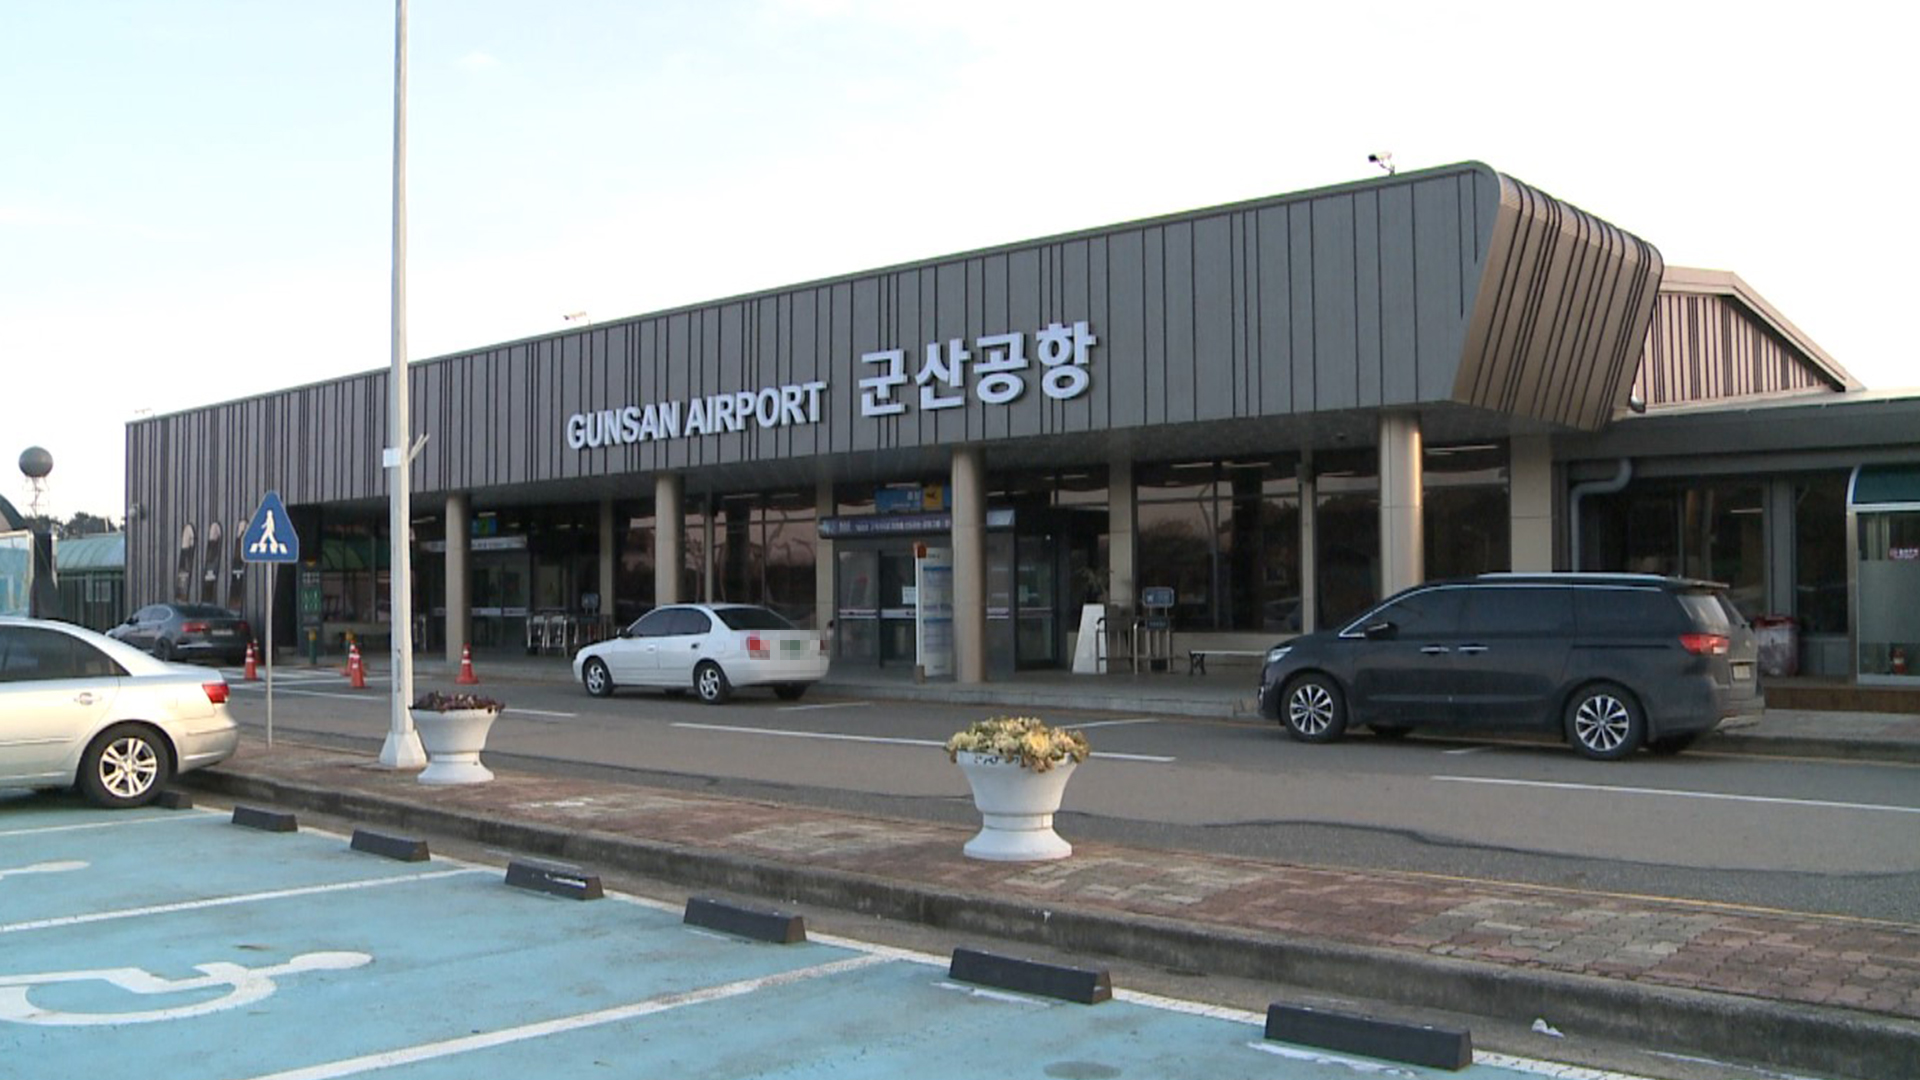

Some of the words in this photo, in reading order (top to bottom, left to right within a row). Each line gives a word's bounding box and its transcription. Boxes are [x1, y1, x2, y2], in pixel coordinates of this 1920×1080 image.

[858, 321, 1097, 418] 군산공항
[567, 401, 681, 449] GUNSAN
[684, 381, 828, 437] AIRPORT
